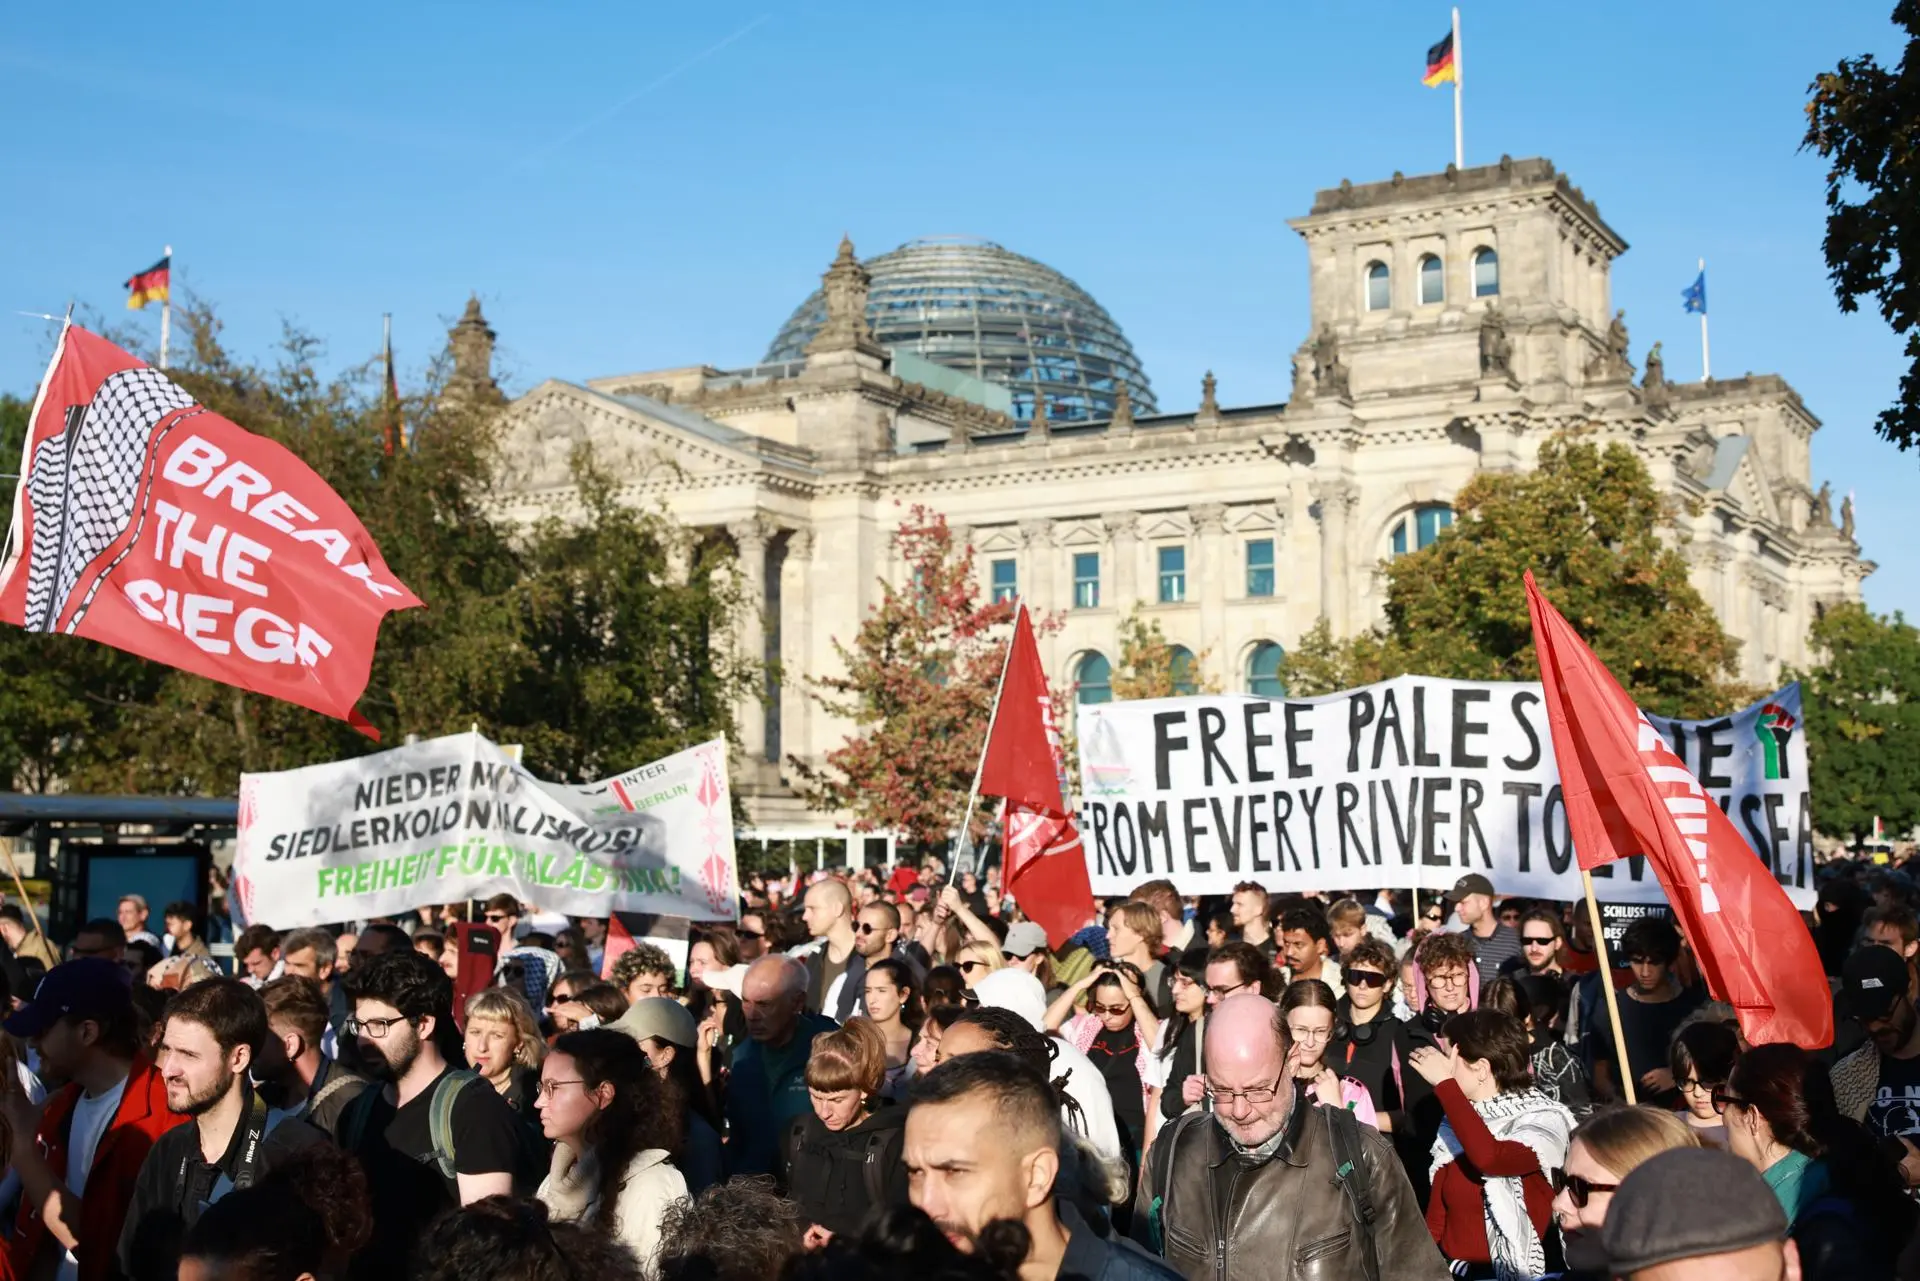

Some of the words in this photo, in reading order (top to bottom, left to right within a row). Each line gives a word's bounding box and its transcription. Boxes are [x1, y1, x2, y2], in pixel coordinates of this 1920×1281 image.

[154, 498, 273, 598] THE
[1153, 701, 1314, 790] FREE
[354, 763, 461, 812] NIEDER
[622, 763, 667, 786] INTER
[635, 784, 688, 811] BERLIN
[1184, 785, 1323, 873] EVERY
[1336, 776, 1493, 869] RIVER
[1502, 780, 1573, 875] TO
[435, 837, 514, 878] FÜR
[1603, 905, 1645, 918] SCHLUSS
[245, 1140, 256, 1163] Nikon
